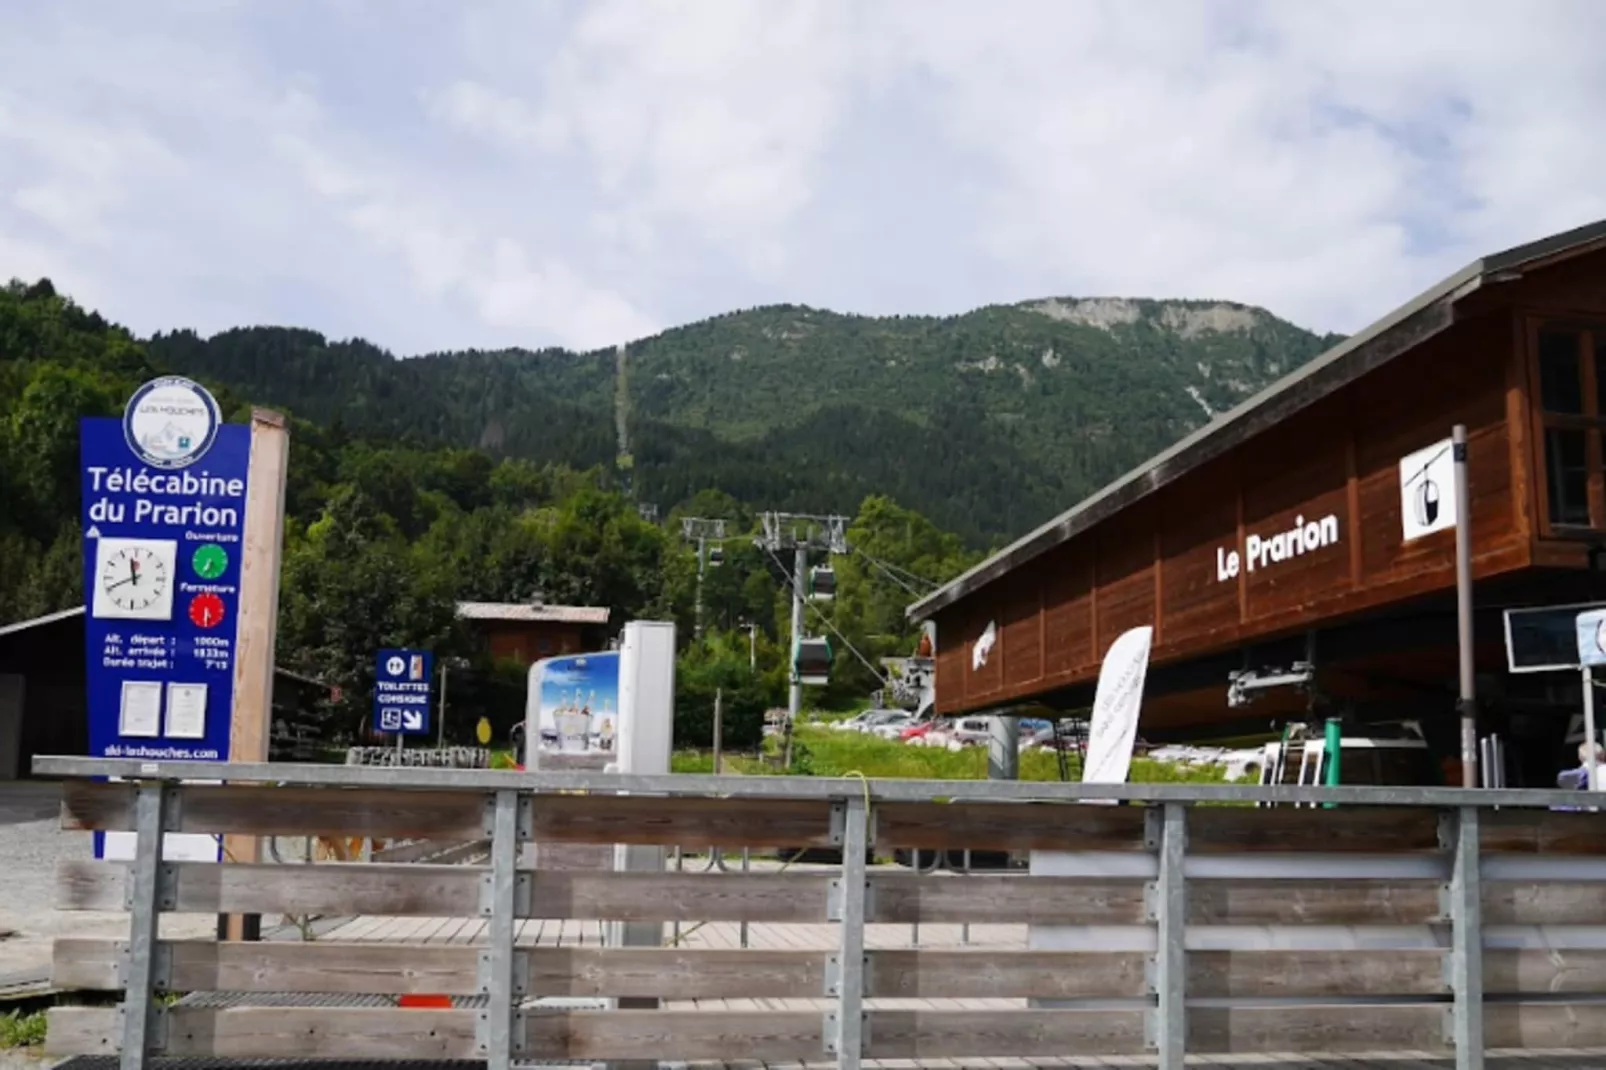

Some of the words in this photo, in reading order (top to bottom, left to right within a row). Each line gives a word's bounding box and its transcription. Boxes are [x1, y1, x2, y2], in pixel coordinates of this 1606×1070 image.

[87, 466, 244, 496] Télécabine
[89, 498, 124, 522] du
[135, 499, 238, 526] Prarion
[185, 530, 239, 543] Ouverture
[1217, 547, 1240, 582] Le
[1246, 514, 1339, 572] Prarion
[180, 582, 236, 594] Fermeture
[130, 633, 165, 646] départ
[377, 681, 429, 692] TOILETTES
